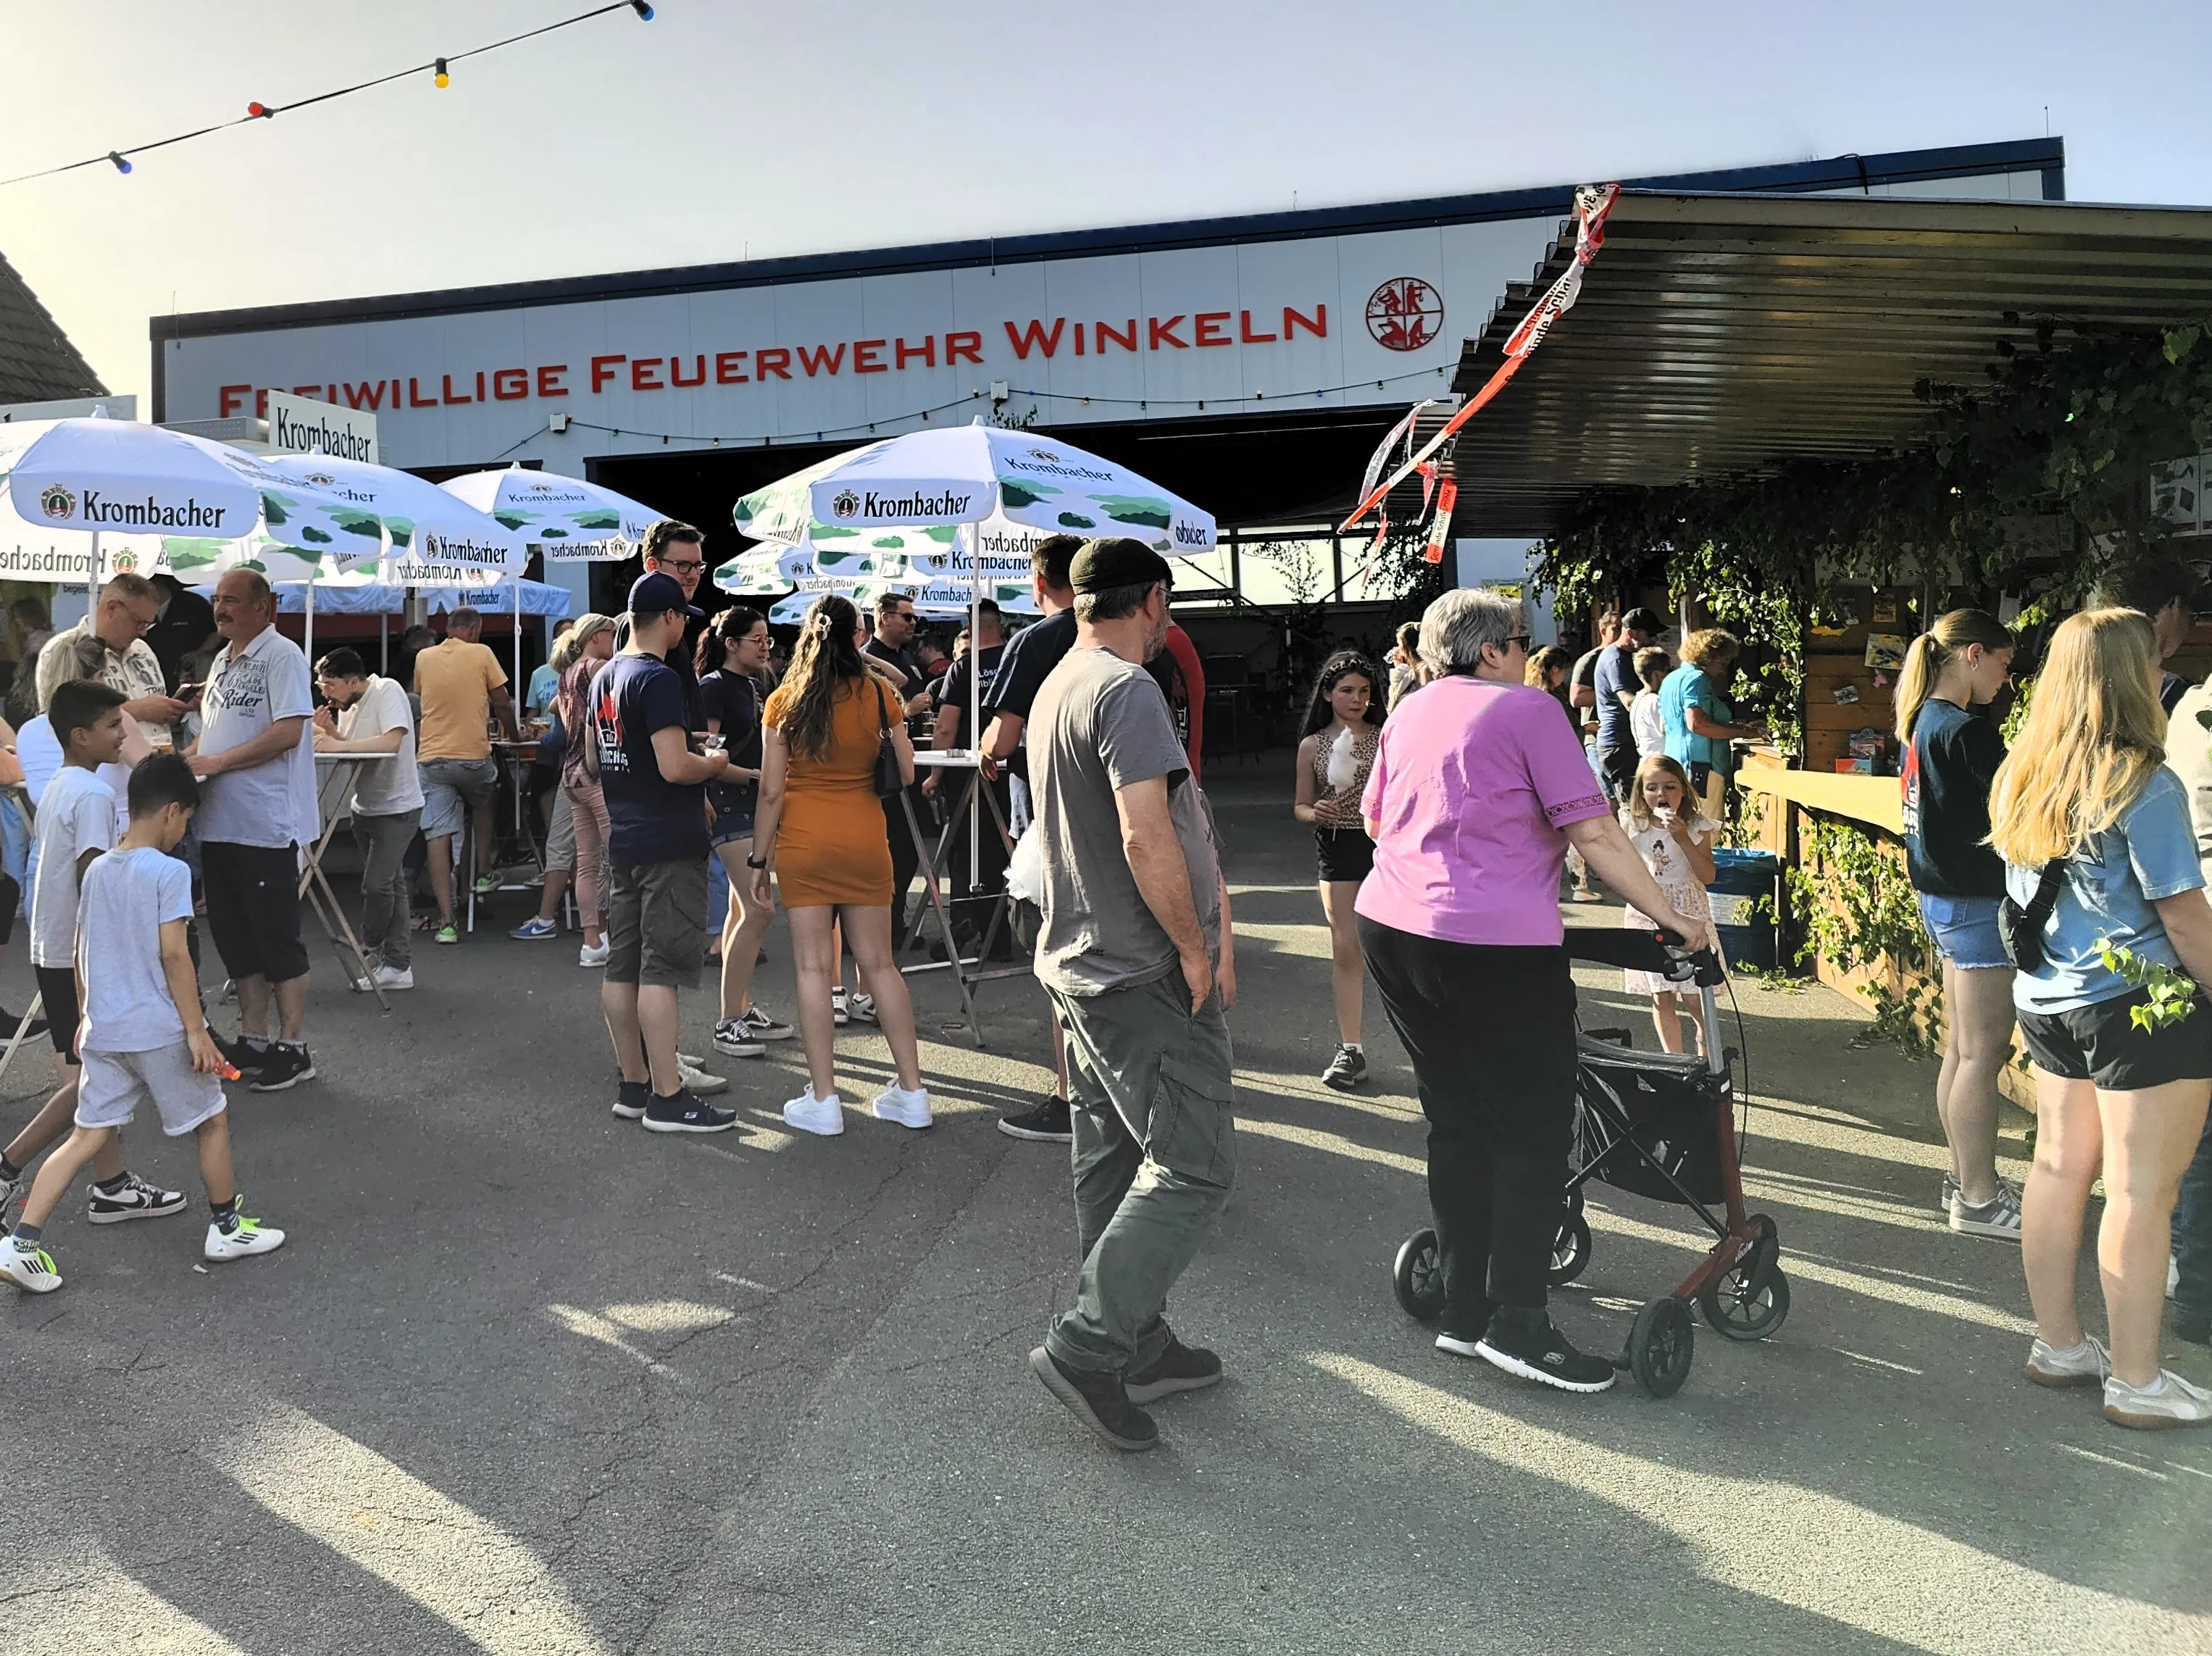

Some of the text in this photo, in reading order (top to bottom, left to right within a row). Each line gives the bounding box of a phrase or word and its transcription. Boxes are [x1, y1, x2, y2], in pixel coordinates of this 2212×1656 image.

[590, 330, 985, 394] FEUERWEHR
[1003, 303, 1327, 360] WINKELN
[277, 407, 372, 463] Krombacher
[1003, 457, 1114, 482] Krombacher
[83, 490, 226, 528] Krombacher
[509, 493, 587, 503] Krombacher
[864, 488, 971, 517] Krombacher
[466, 590, 500, 605] Krombacher
[921, 585, 972, 604] Krombach
[221, 688, 263, 710] Rider
